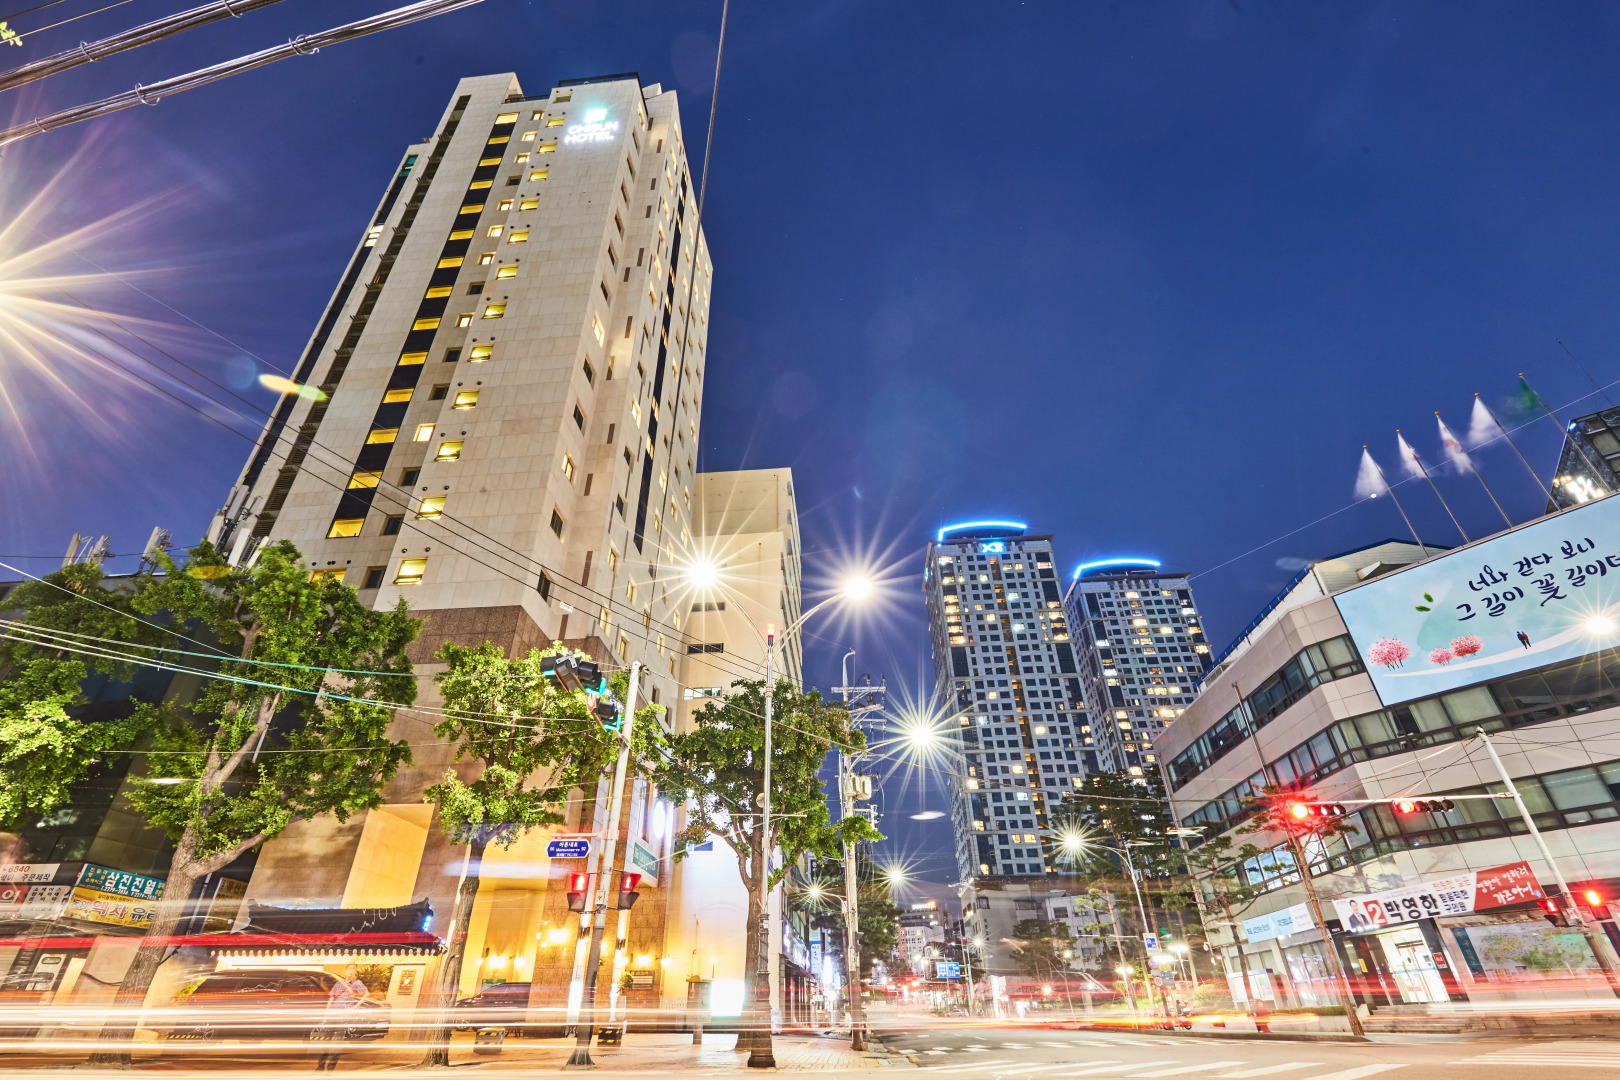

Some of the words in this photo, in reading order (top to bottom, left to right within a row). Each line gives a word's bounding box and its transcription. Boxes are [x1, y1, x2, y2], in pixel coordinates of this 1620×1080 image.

[564, 132, 614, 145] HOTEL
[1468, 565, 1508, 592] 너와
[1513, 553, 1553, 578] 걷다
[1560, 537, 1595, 560] 보니
[1455, 603, 1476, 621] 그
[1481, 586, 1524, 617] 길이
[1530, 573, 1567, 607] 꽃
[105, 871, 157, 895] 삼진진열
[1502, 865, 1529, 883] 일하러
[92, 900, 129, 918] 액자
[1367, 903, 1386, 924] 2
[1383, 893, 1441, 921] 박영한
